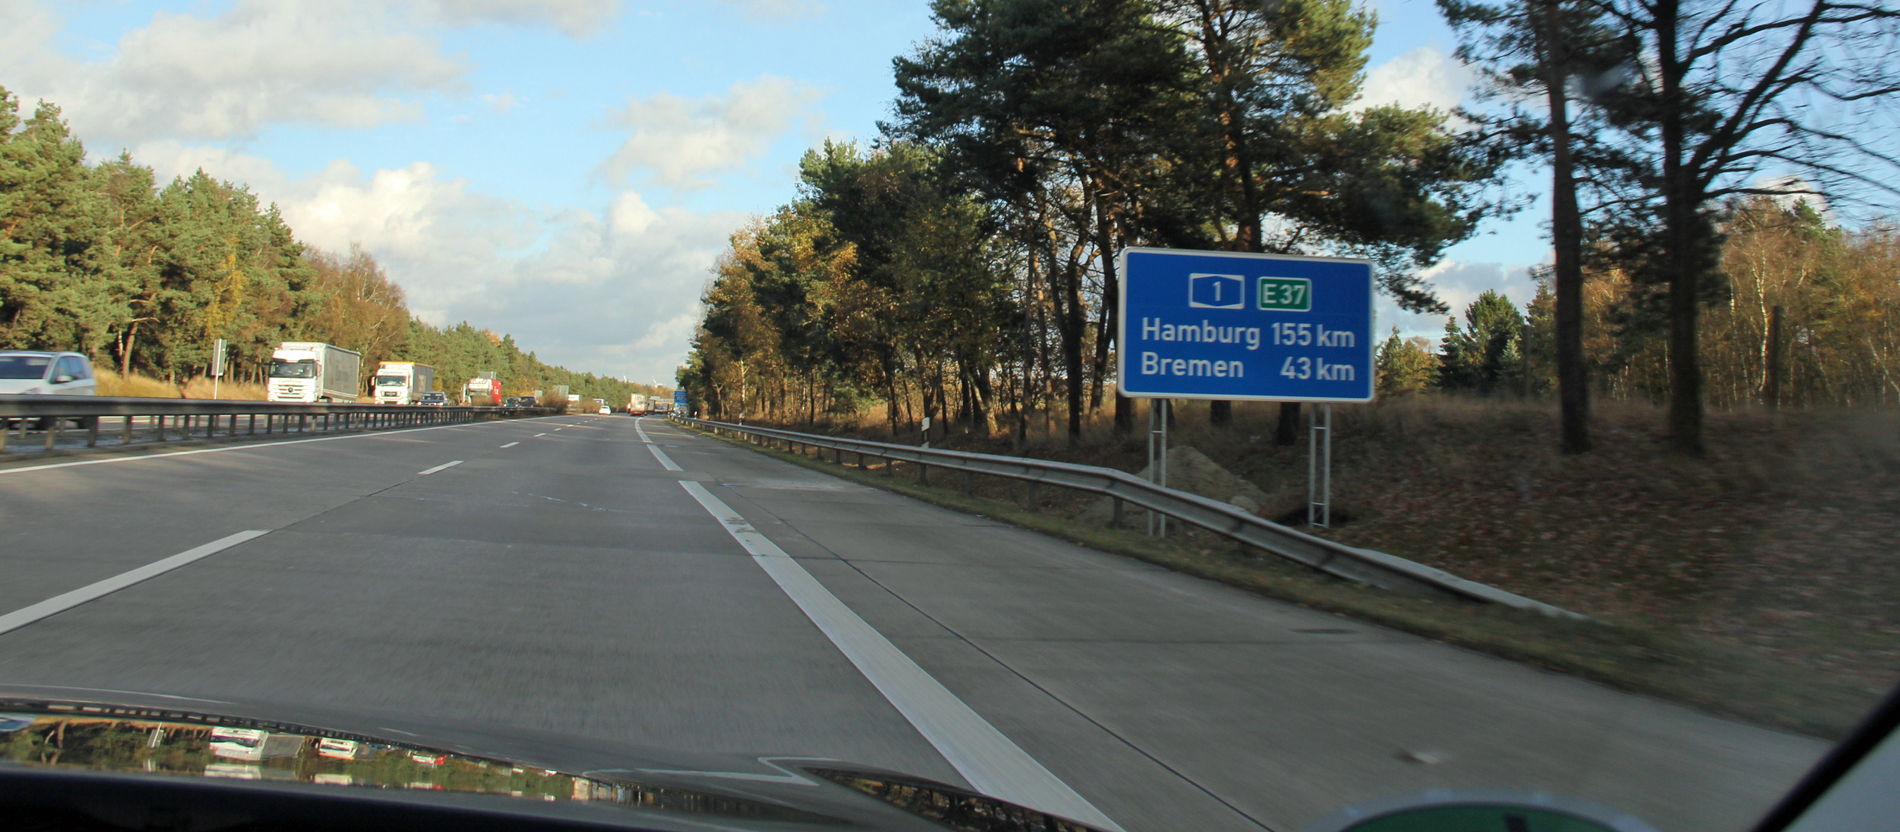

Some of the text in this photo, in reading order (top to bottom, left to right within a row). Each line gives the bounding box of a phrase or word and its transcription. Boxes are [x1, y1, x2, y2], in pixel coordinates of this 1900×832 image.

[1212, 281, 1222, 302] 1
[1142, 316, 1356, 351] Hamburg 155 km
[1141, 351, 1355, 382] Bremen 43 km
